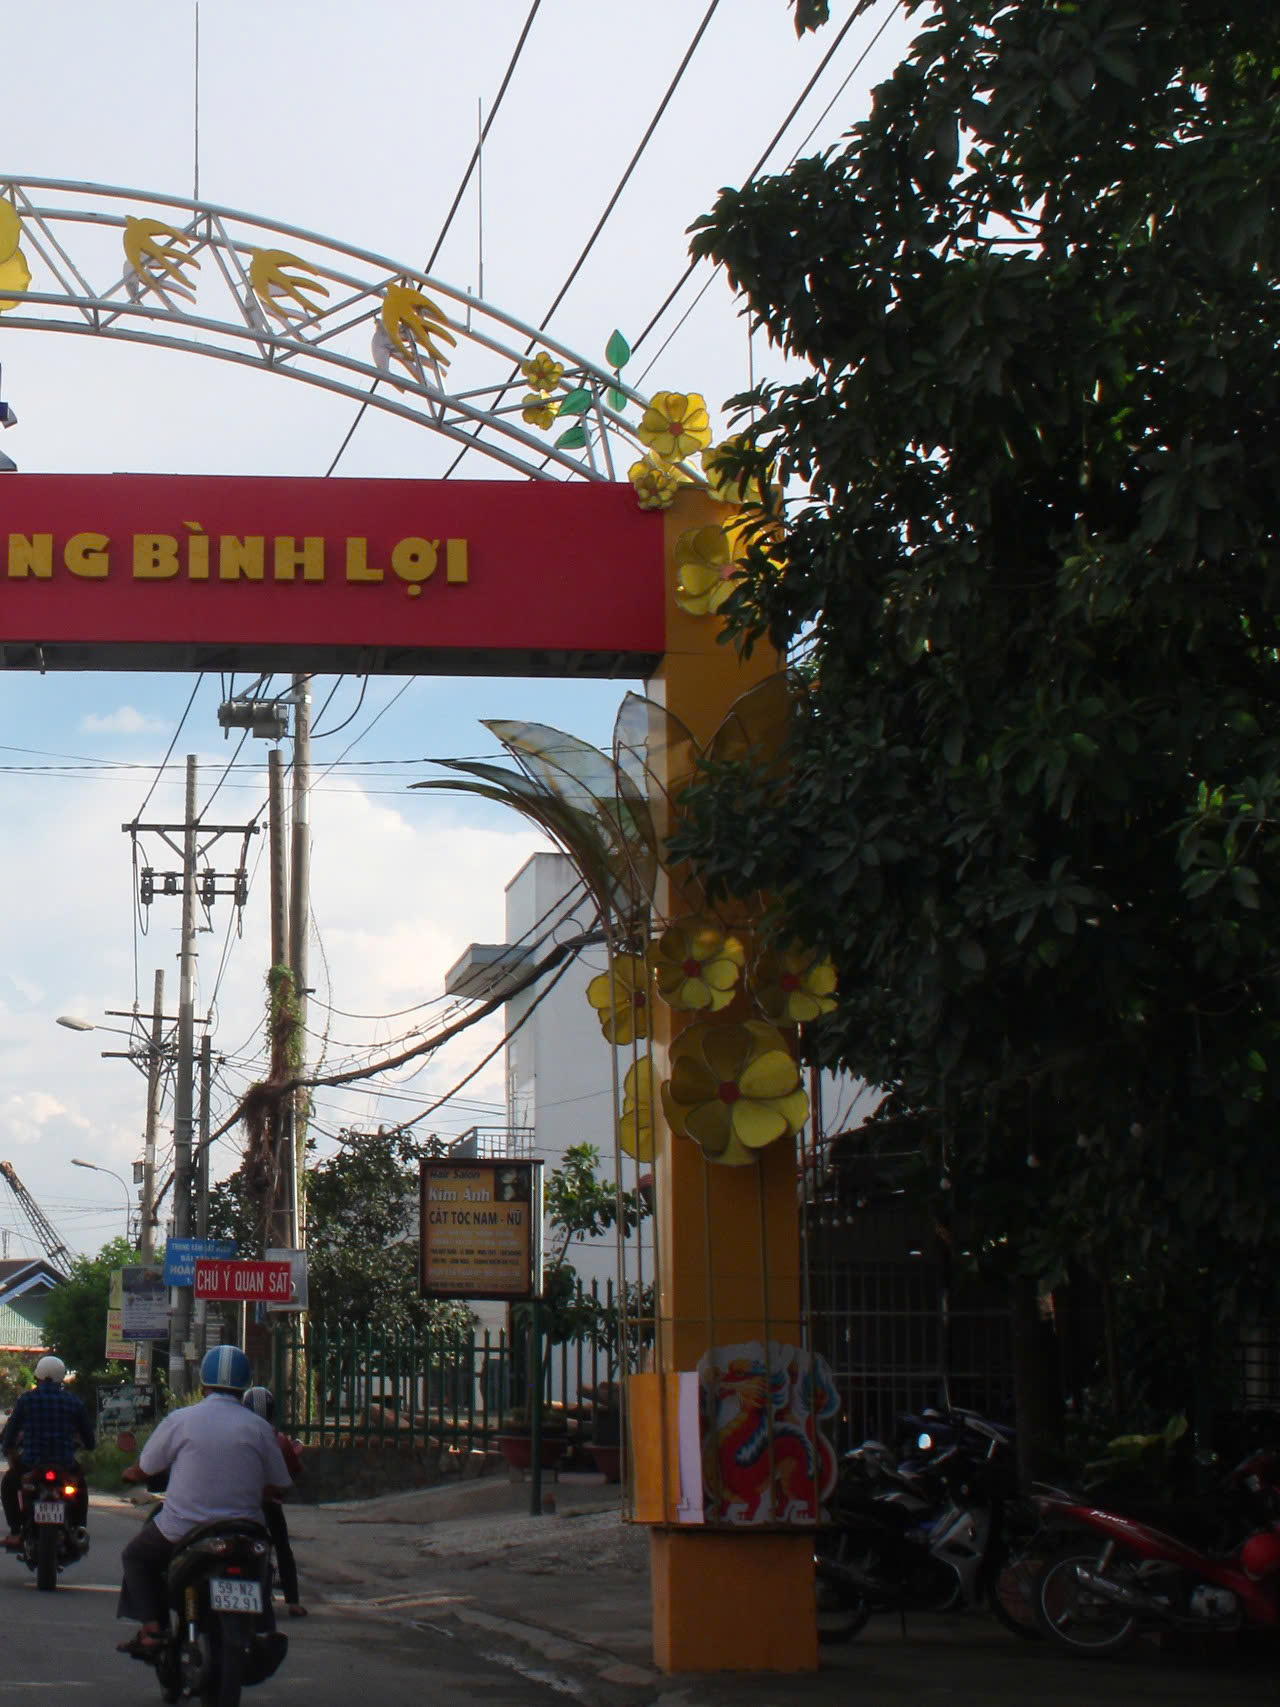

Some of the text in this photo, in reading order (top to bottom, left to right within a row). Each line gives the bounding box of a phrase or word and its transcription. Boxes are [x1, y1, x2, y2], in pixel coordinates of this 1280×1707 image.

[133, 521, 325, 581] BÌNH
[346, 536, 468, 596] LỢI
[455, 1167, 481, 1179] Salon
[428, 1187, 457, 1201] Kim
[473, 1211, 497, 1225] NAM
[197, 1264, 289, 1293] CHÚ Ý QUAN SÁT
